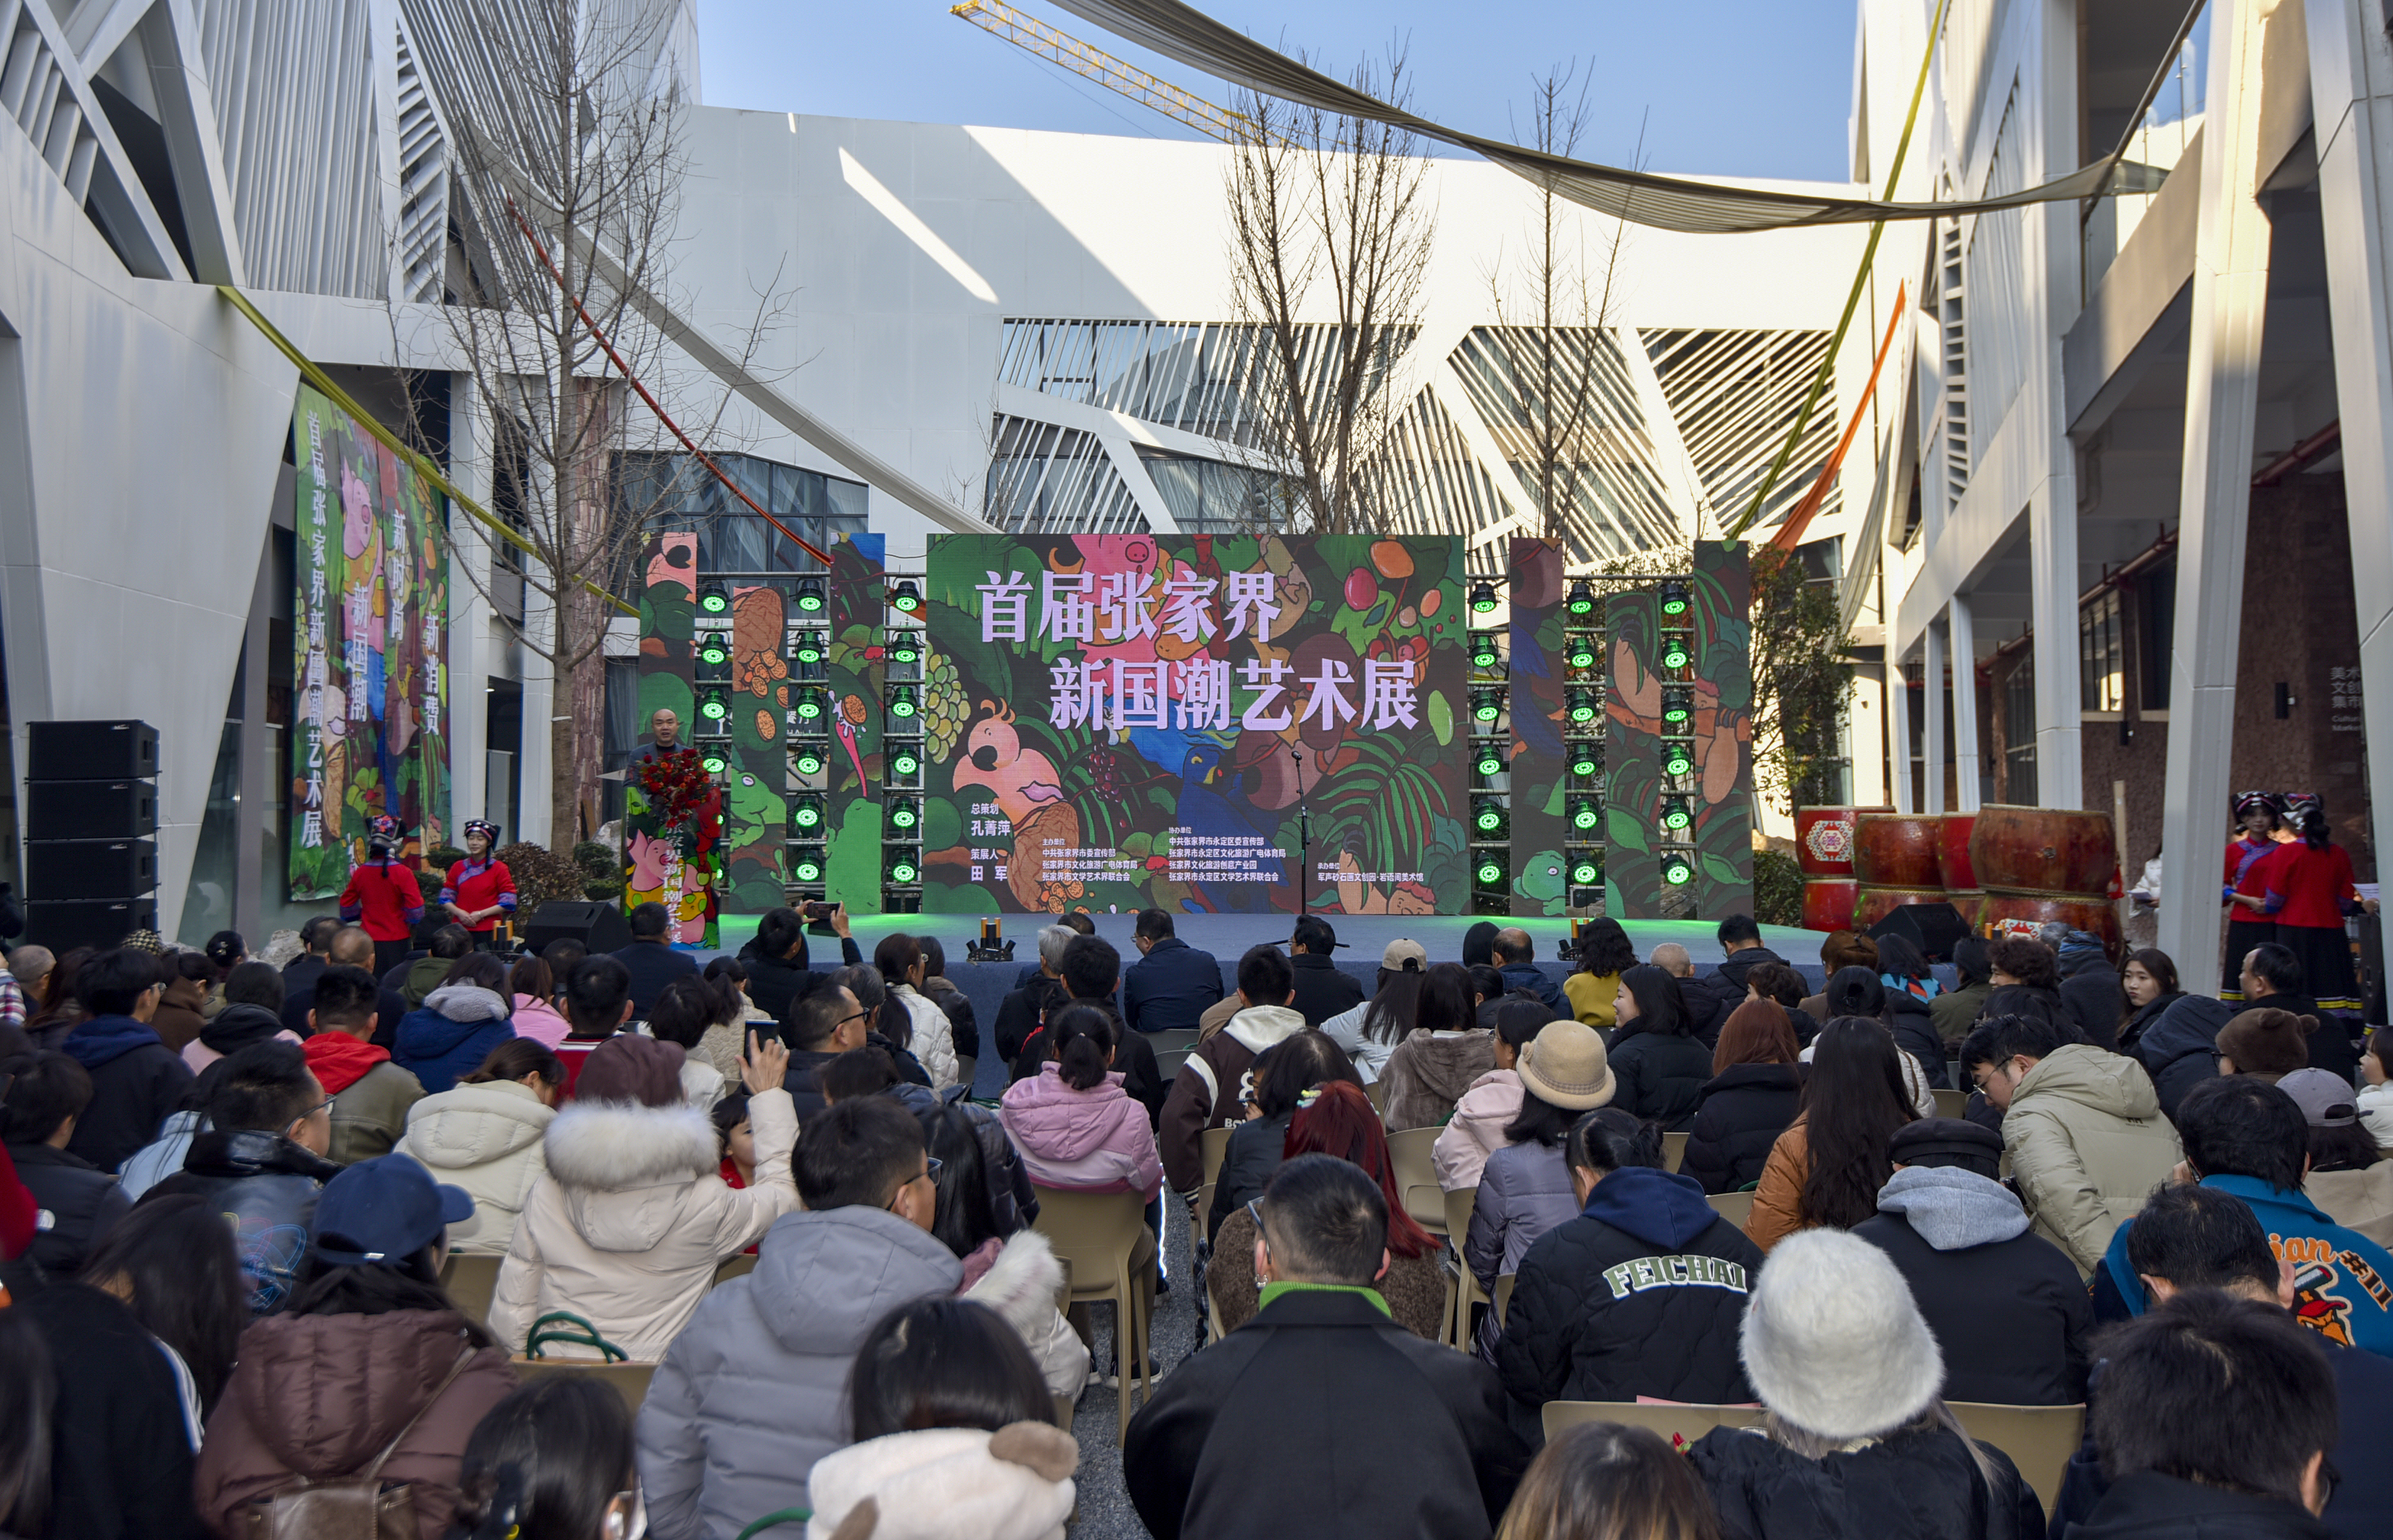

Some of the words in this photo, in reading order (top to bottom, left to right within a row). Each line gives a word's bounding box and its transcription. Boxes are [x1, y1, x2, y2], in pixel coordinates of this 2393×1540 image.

[391, 508, 406, 640] 新时尚
[975, 570, 1281, 642] 首届张家界
[302, 410, 326, 848] 首届张家界新国潮艺术展
[352, 584, 368, 721] 新国潮
[425, 611, 439, 734] 新消费
[1049, 658, 1419, 731] 新国潮艺术展
[971, 803, 999, 815] 总策划
[971, 820, 1011, 836] 孔菁萍
[1169, 837, 1264, 846] 中共张家界市永定区委宣传部
[970, 848, 999, 860] 策展人
[1042, 848, 1116, 858] 中共张家界市委宣传部
[1169, 848, 1286, 858] 张家界市永定区文化旅游广电体育局
[1042, 860, 1138, 869] 张家界市文化旅游广电体育局
[1169, 861, 1257, 869] 张家界文化旅游创意产业园
[1042, 872, 1131, 882] 张家界市文学艺术界联合会
[1169, 872, 1279, 882] 张家界市永定区文学艺术界联合会
